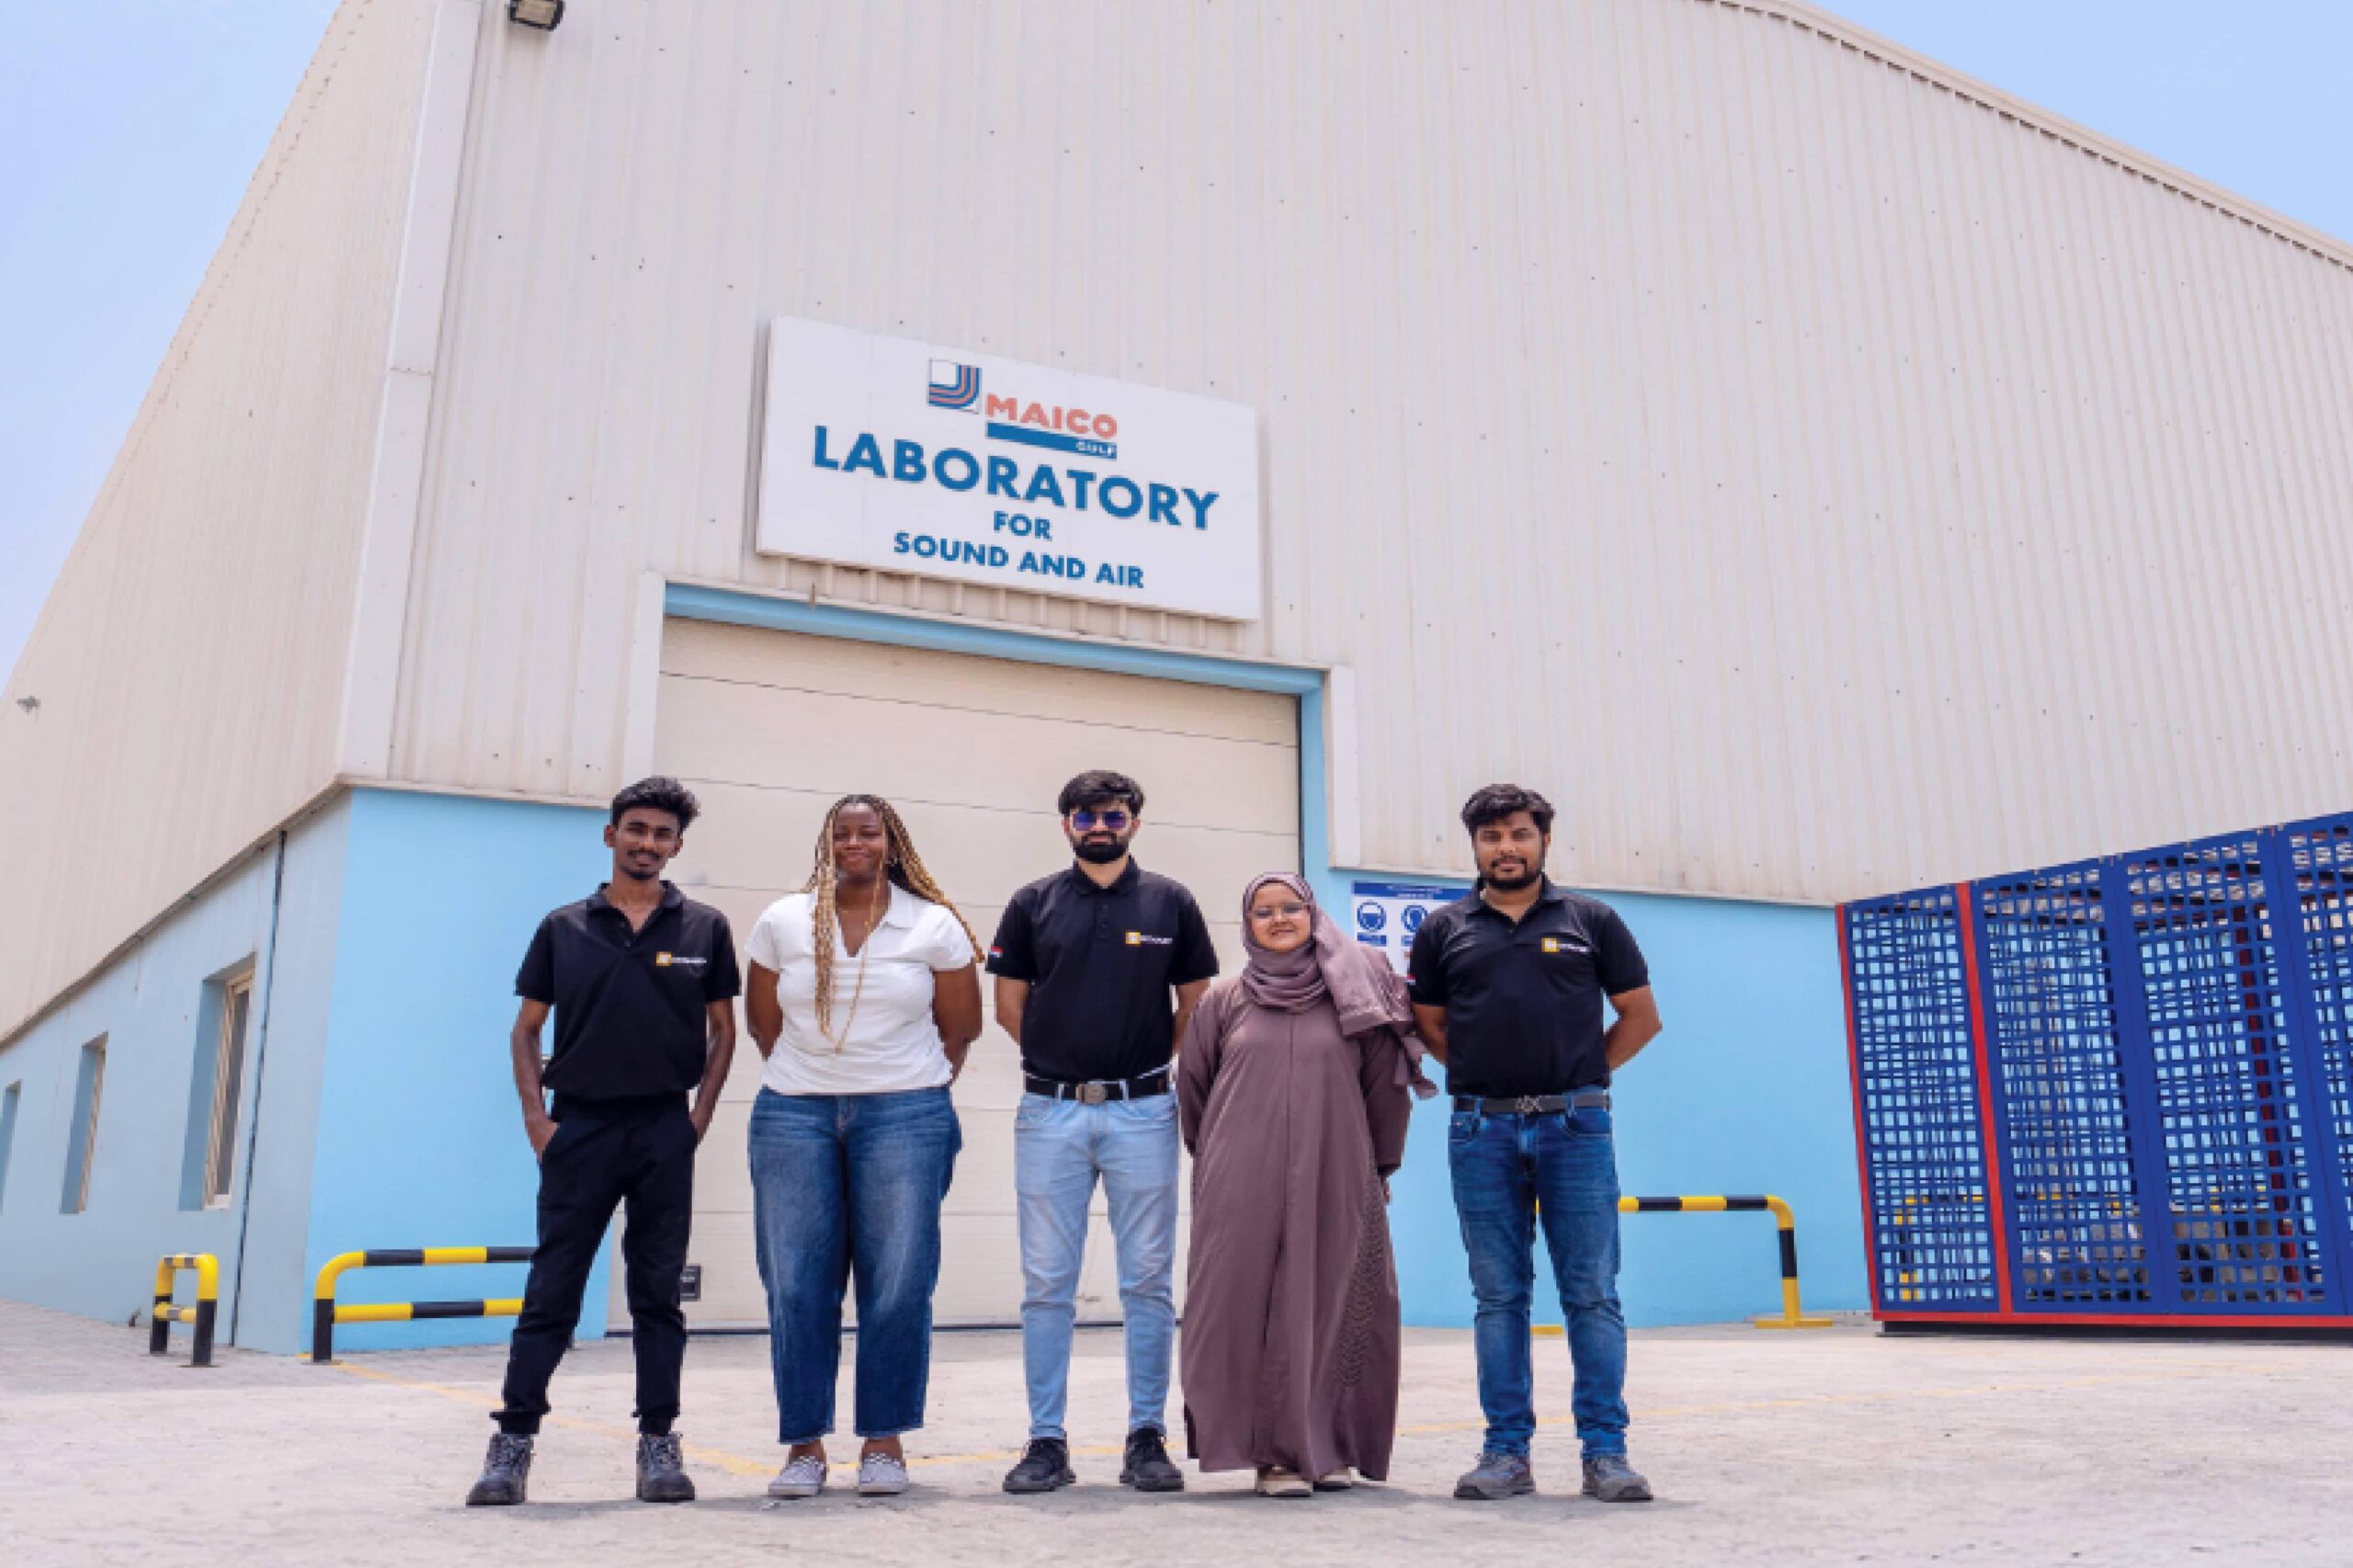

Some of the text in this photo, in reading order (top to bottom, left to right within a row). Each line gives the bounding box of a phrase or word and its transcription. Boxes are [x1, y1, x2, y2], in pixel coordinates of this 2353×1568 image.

[985, 392, 1119, 439] MAICO
[813, 425, 1220, 530] LABORATORY
[993, 509, 1052, 541] FOR
[893, 531, 1144, 589] SOUND AND AIR
